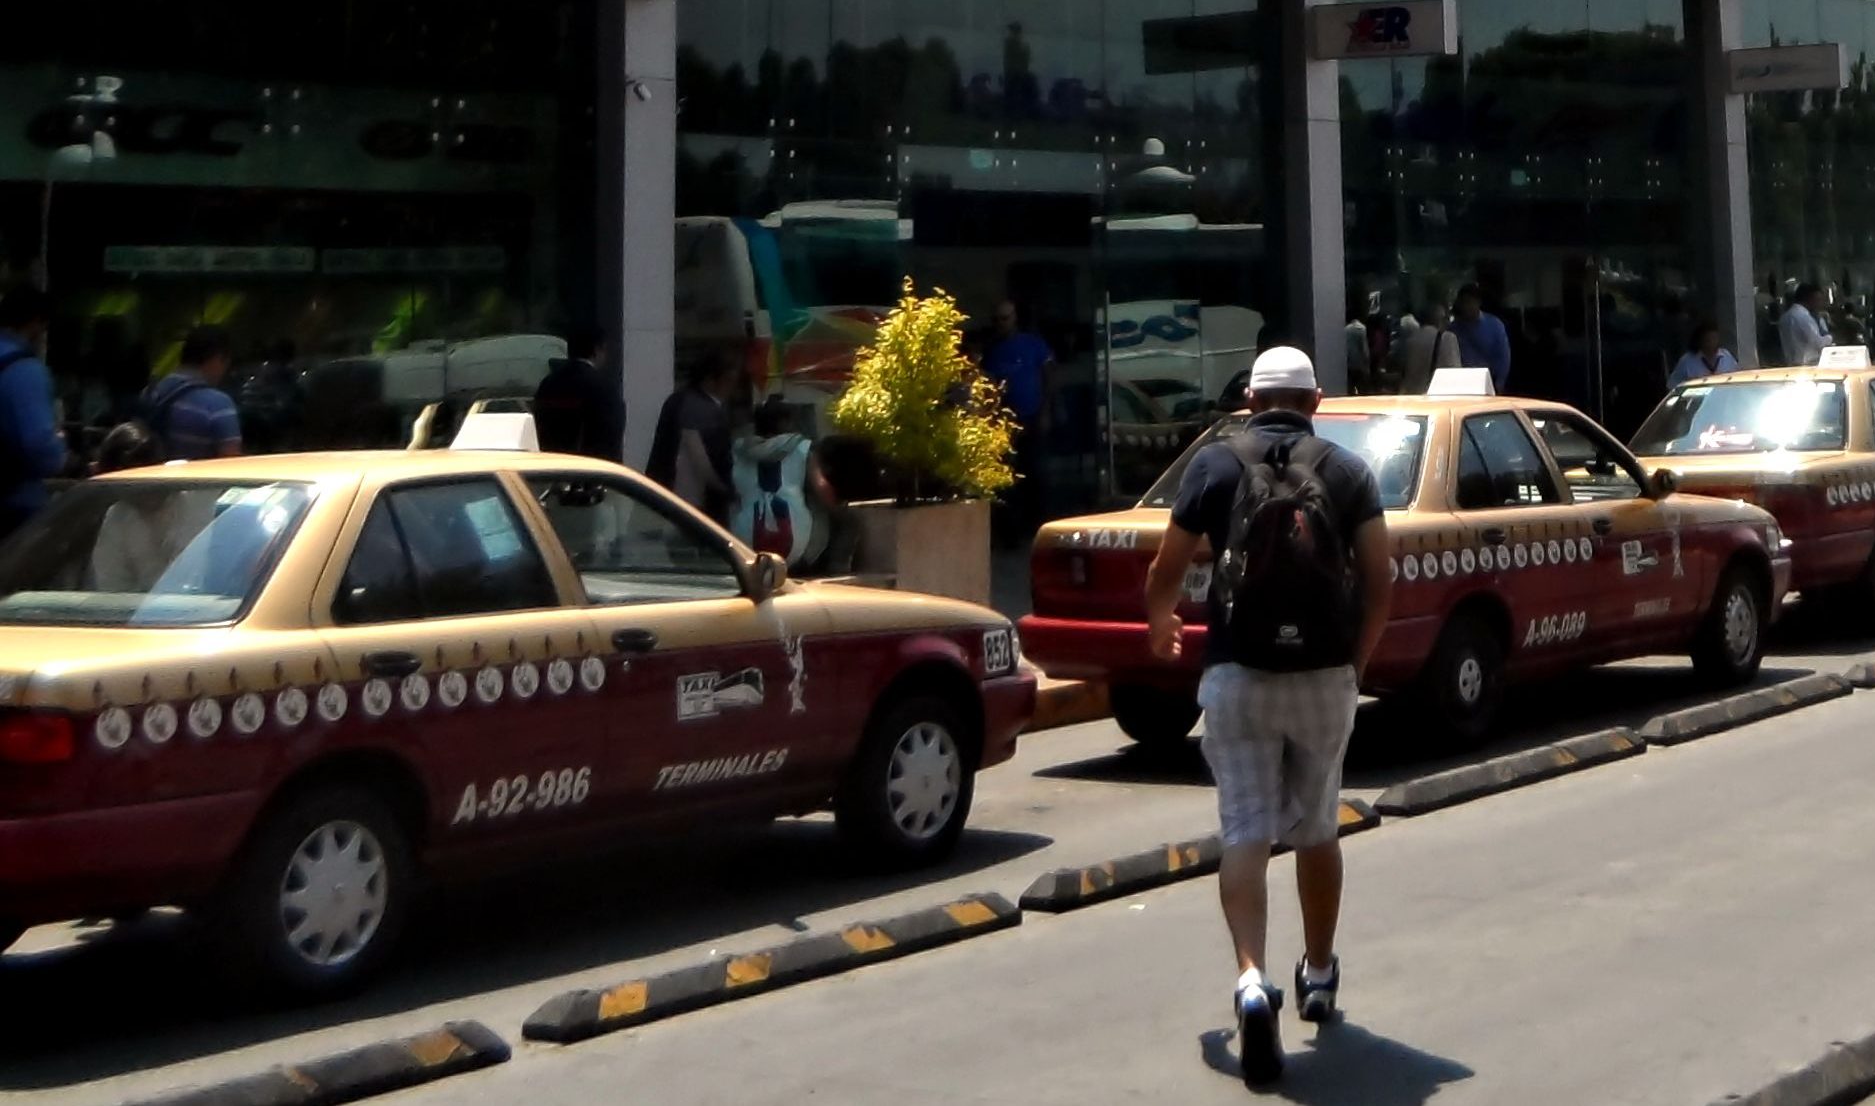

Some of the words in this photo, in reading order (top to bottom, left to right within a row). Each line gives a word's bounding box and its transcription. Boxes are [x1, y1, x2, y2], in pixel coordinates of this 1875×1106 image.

[1088, 529, 1138, 549] TAXI
[986, 633, 1009, 670] 852
[653, 748, 788, 791] TERMINALES
[451, 766, 592, 826] A-92-986
